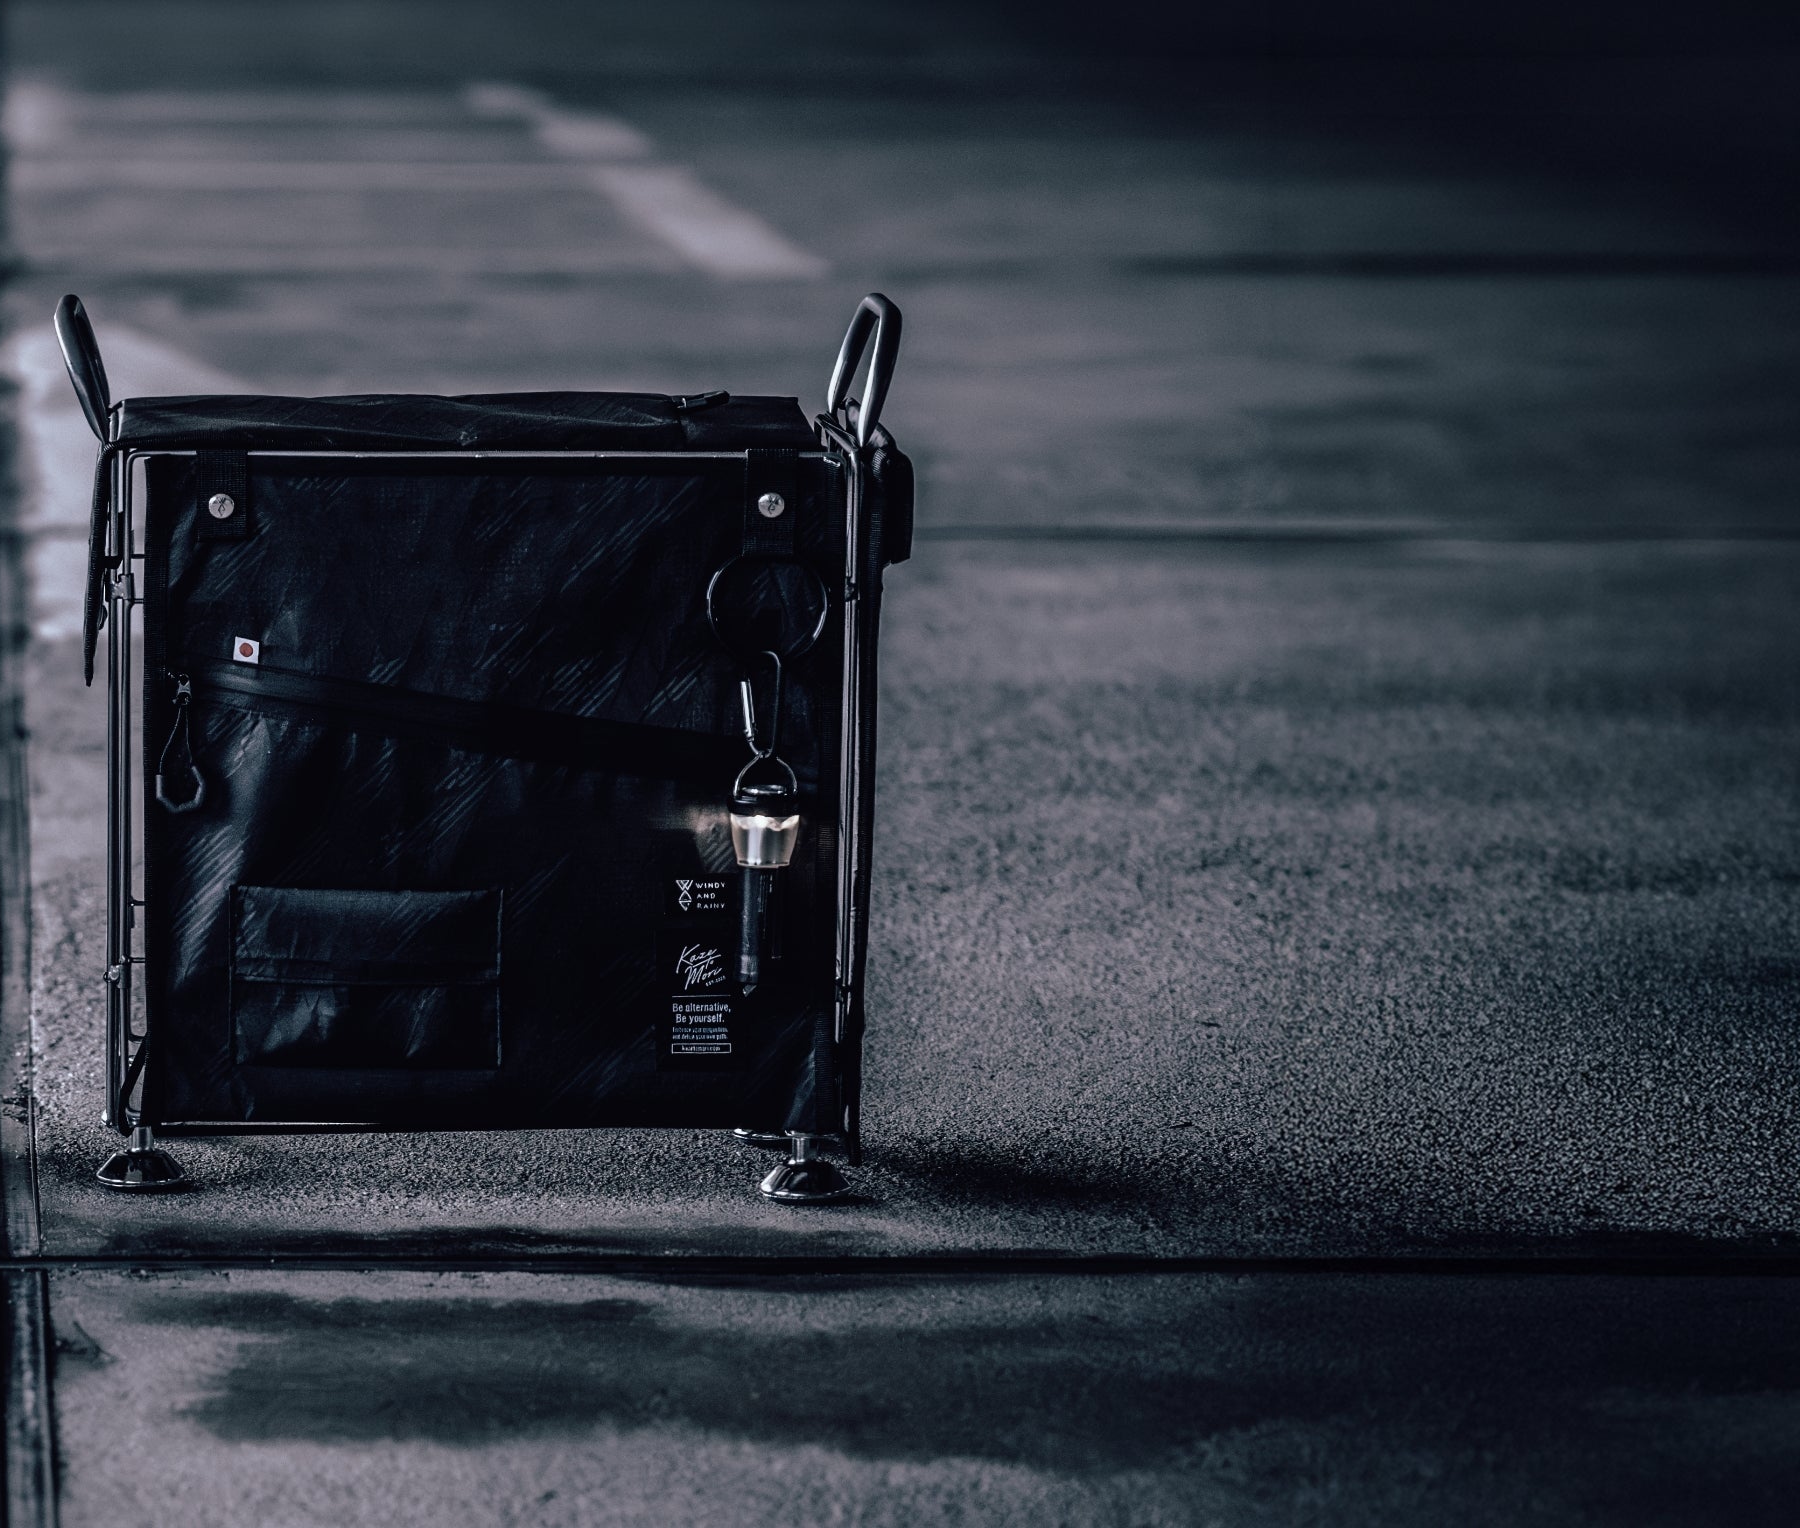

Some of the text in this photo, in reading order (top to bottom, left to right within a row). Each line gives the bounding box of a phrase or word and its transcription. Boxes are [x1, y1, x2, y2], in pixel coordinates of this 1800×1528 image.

[695, 881, 726, 889] WINDY
[696, 892, 716, 900] AND
[696, 902, 726, 910] RAINY
[675, 943, 718, 974] Kaze
[672, 1001, 731, 1013] Be alternative,
[675, 1012, 725, 1025] Be yourself.
